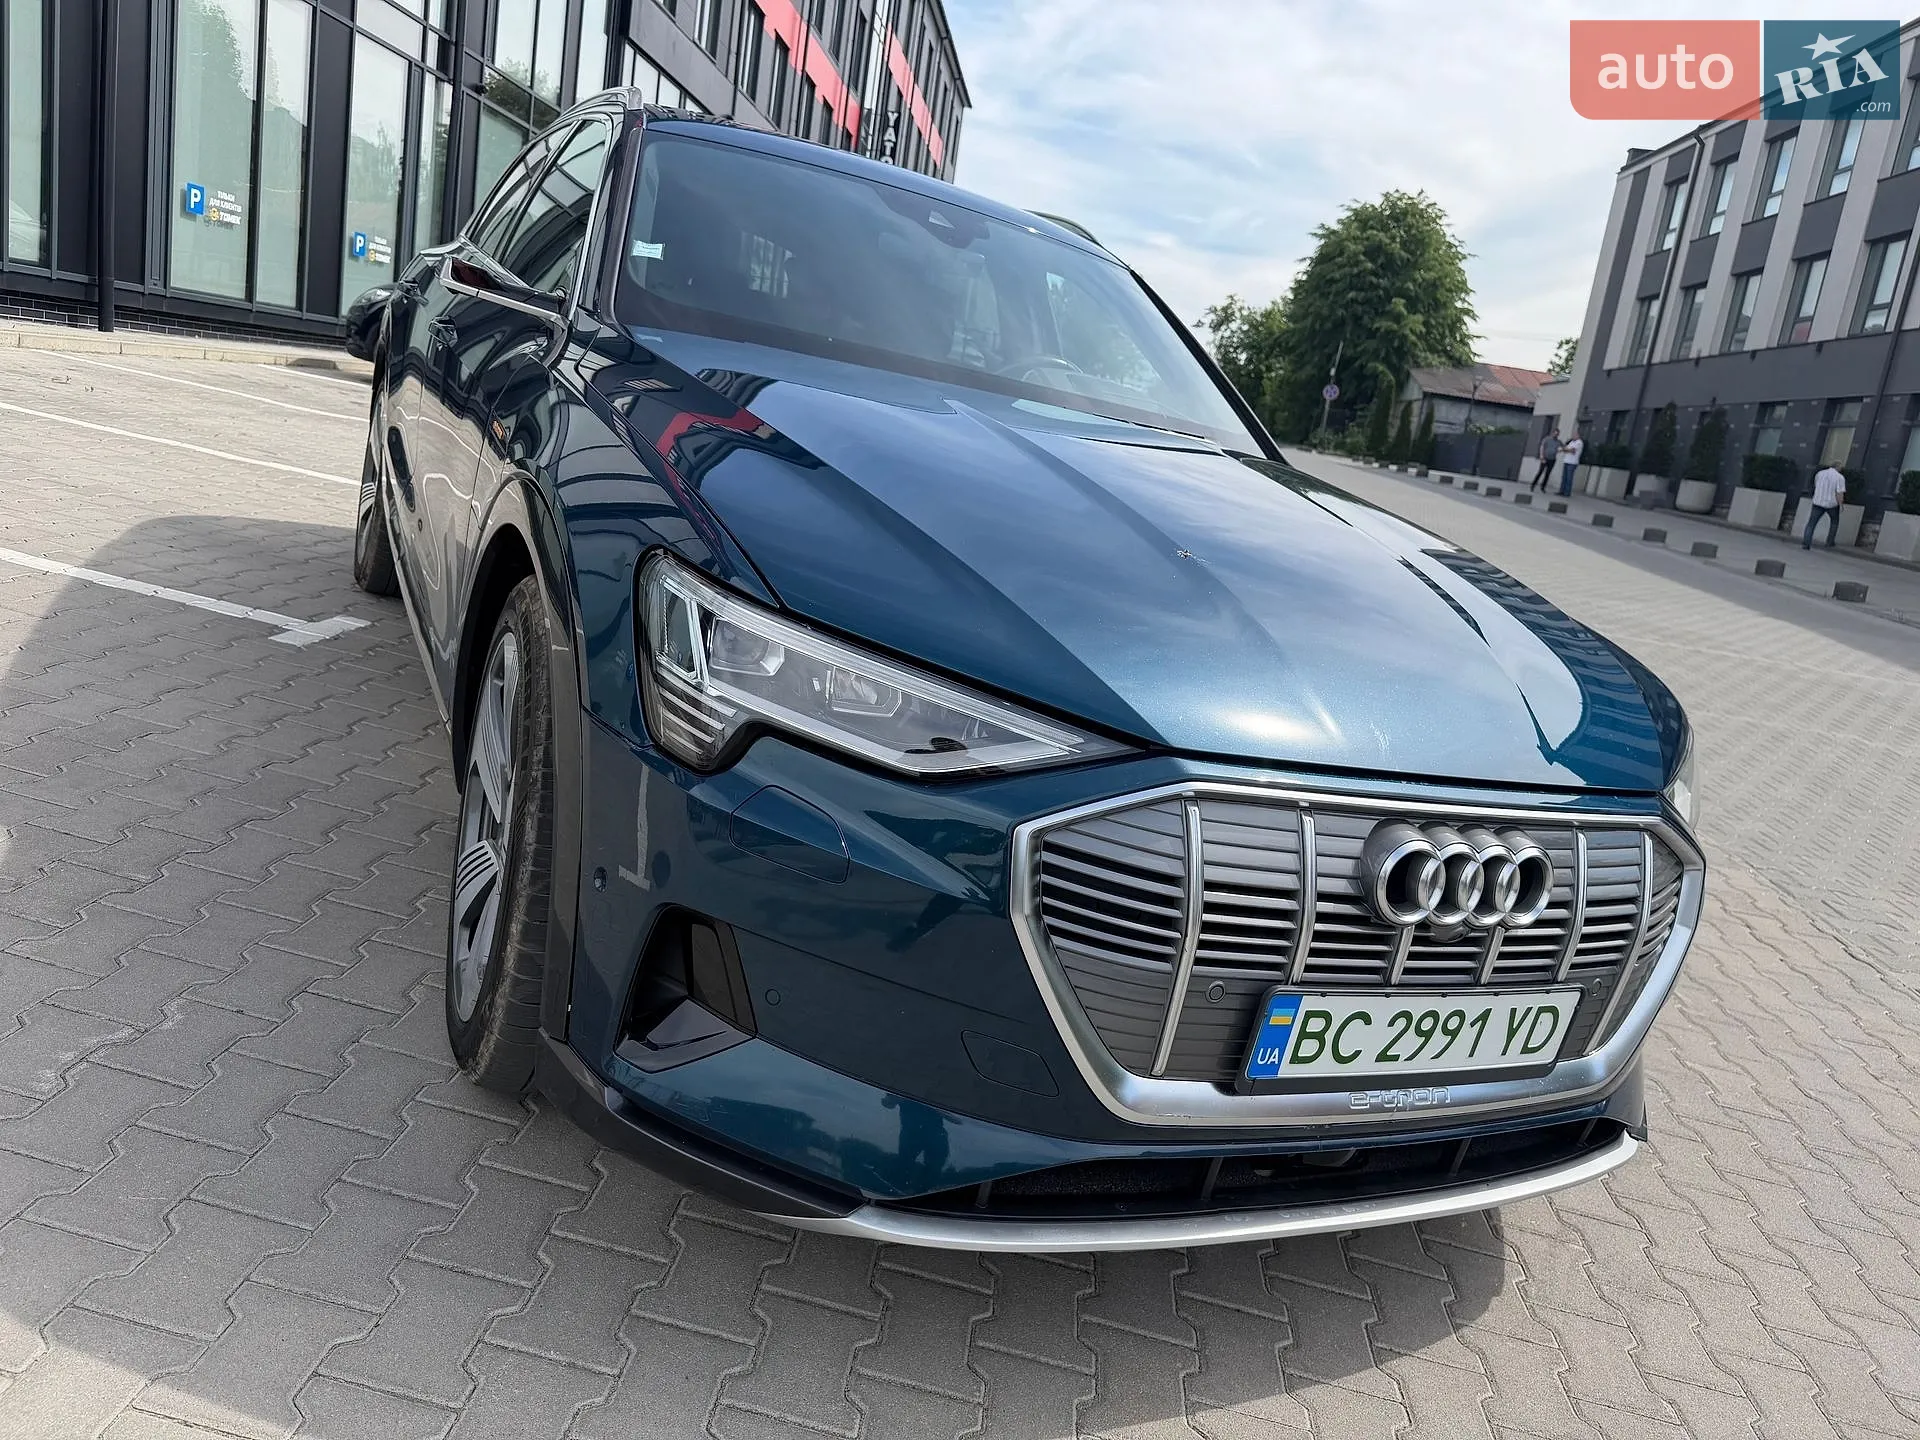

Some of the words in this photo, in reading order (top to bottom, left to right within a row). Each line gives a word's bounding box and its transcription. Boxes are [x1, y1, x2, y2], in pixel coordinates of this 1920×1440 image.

[1289, 1009, 1373, 1065] BC
[1375, 1007, 1493, 1063] 2991
[1500, 1004, 1560, 1057] YD
[1257, 1047, 1280, 1065] UA
[1349, 1086, 1451, 1109] e-tron
